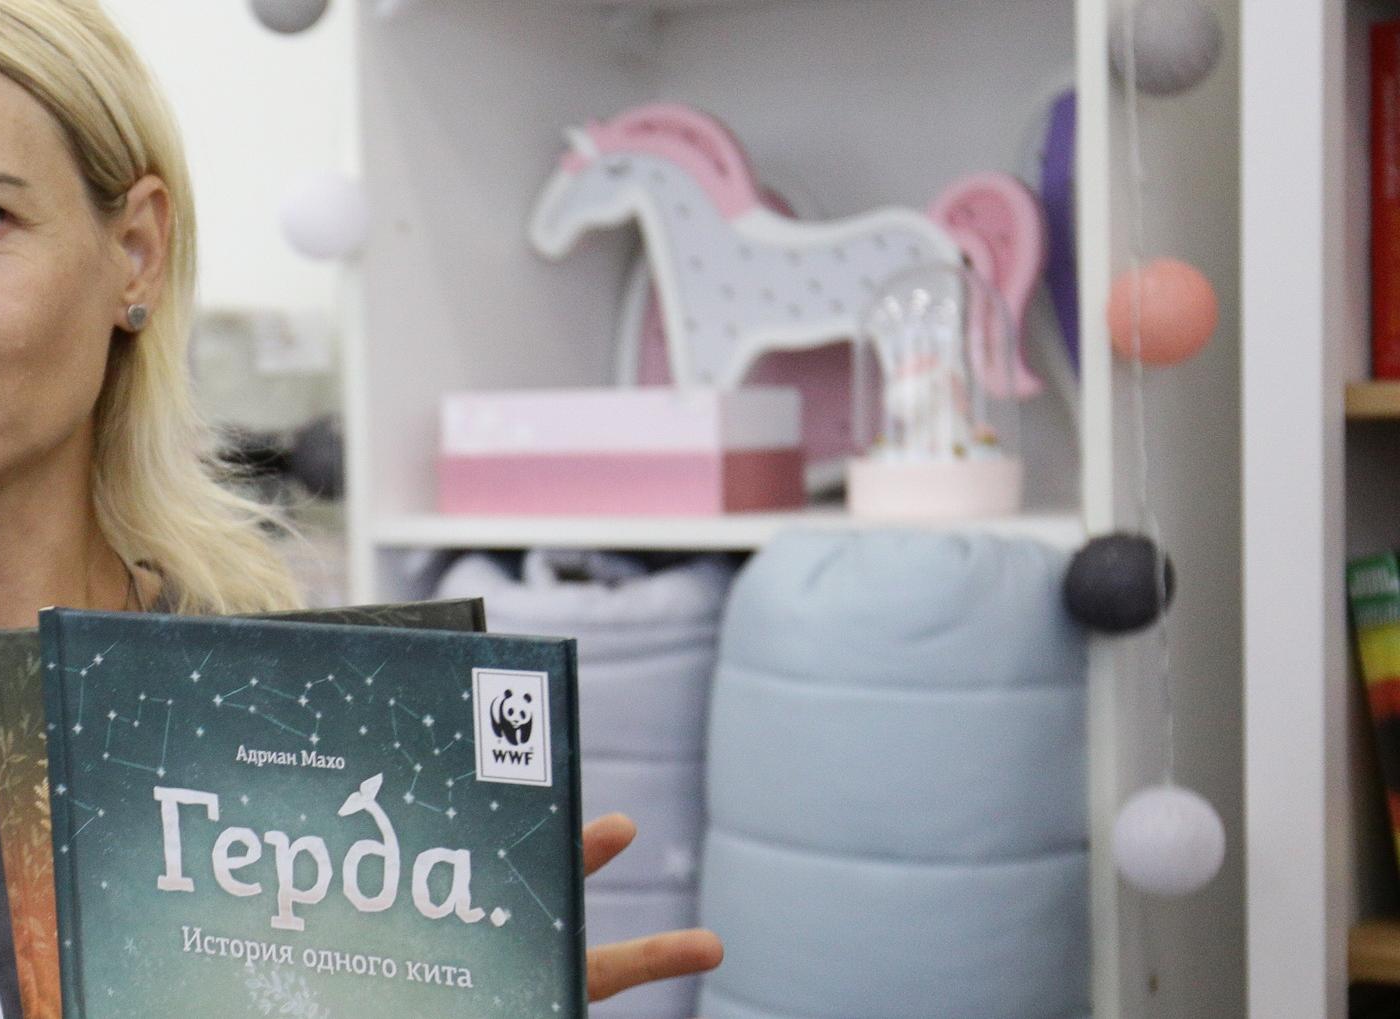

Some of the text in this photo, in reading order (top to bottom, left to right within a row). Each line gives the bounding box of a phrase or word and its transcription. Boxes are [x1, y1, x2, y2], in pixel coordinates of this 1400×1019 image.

[235, 744, 346, 770] Адриан Махо
[492, 748, 534, 766] WWF
[153, 772, 508, 931] Герда.
[181, 925, 474, 988] История одного кита
